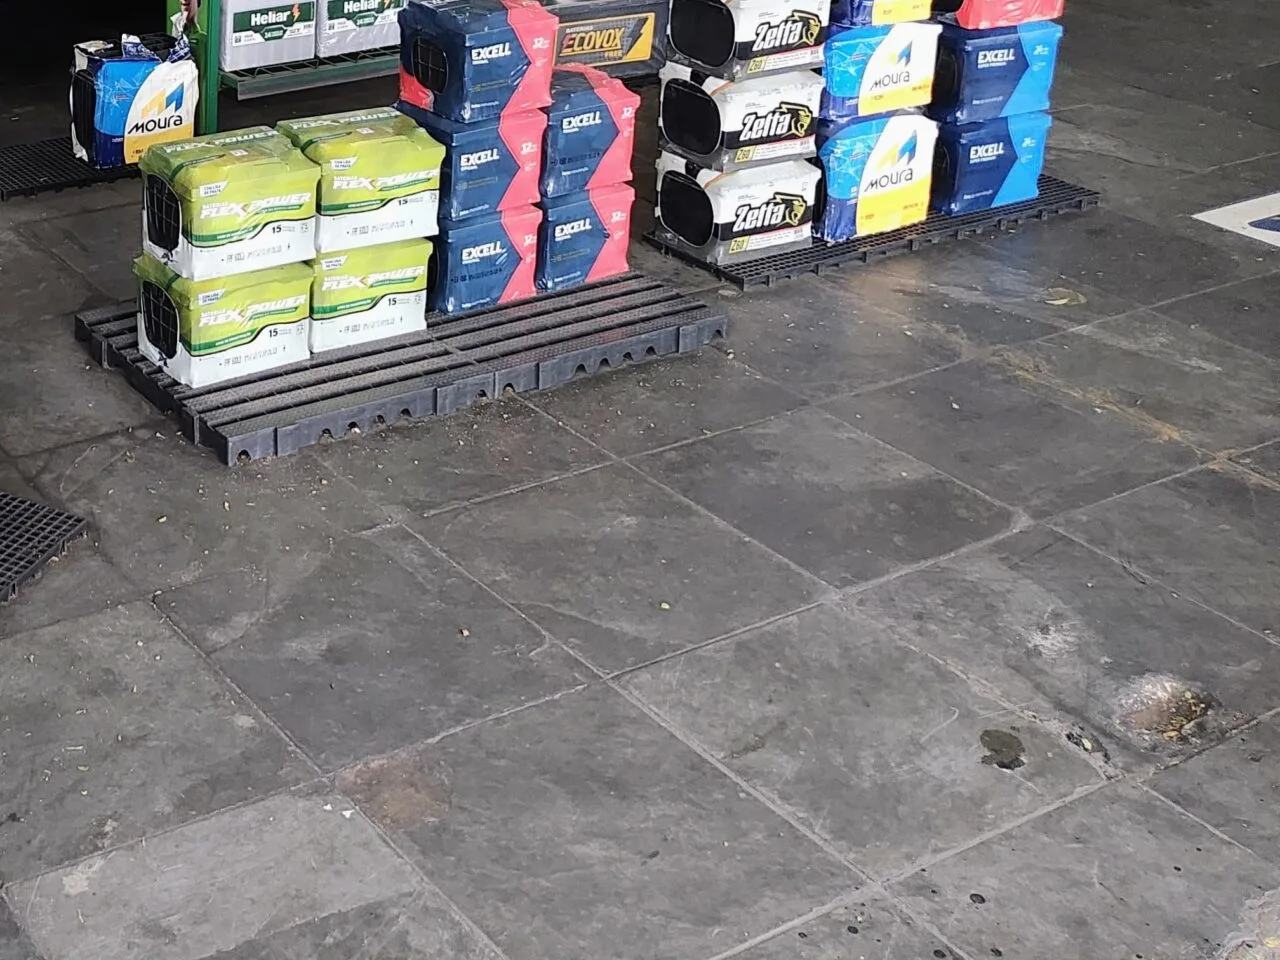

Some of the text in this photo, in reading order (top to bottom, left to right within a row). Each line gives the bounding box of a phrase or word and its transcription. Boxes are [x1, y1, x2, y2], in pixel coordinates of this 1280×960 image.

[251, 10, 291, 27] Heliar
[564, 26, 625, 53] ECOVOX
[752, 20, 804, 52] Zetta
[471, 42, 511, 60] EXCELL
[977, 48, 1015, 65] EXCELL
[870, 71, 910, 91] moura
[127, 115, 183, 134] moura
[562, 111, 602, 130] EXCELL
[739, 111, 792, 141] Zetta
[460, 148, 500, 167] EXCELL
[970, 142, 1005, 159] EXCELL
[864, 168, 913, 192] moura
[398, 198, 408, 206] 15
[732, 203, 786, 232] Zetta
[272, 225, 282, 234] 15
[554, 218, 592, 237] EXCELL
[462, 241, 503, 260] EXCELL
[388, 298, 397, 306] 15
[269, 328, 278, 338] 15
